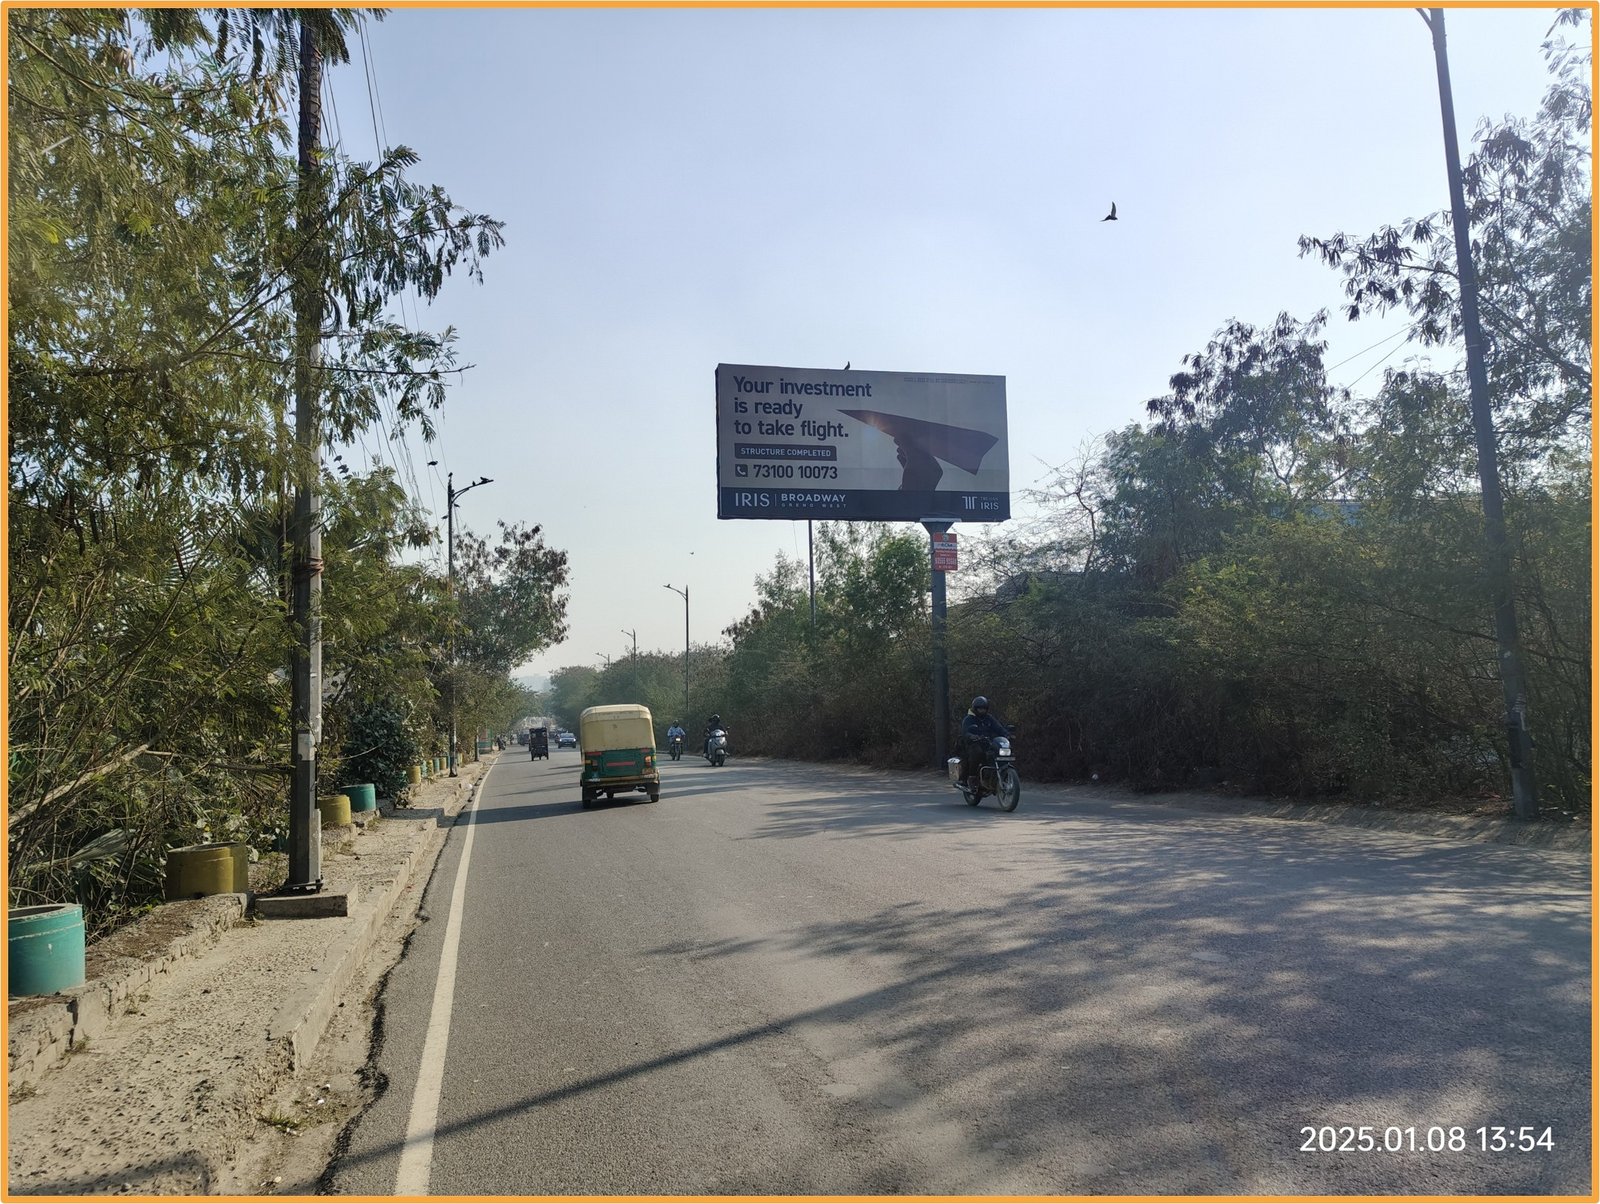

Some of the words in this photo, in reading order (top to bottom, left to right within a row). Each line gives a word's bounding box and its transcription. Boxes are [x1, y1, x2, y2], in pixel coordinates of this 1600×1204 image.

[733, 375, 774, 394] Your
[780, 378, 872, 397] investment
[734, 397, 749, 414] is
[754, 399, 803, 419] ready
[734, 420, 752, 435] to
[758, 420, 795, 436] take
[800, 420, 849, 441] flight.
[740, 447, 785, 456] STRUCTURE
[787, 448, 831, 457] COMPLETED
[753, 464, 794, 479] 73100
[798, 465, 838, 480] 10073
[735, 492, 770, 508] IRIS
[781, 493, 847, 502] BROADWAY
[980, 501, 1000, 511] IRIS
